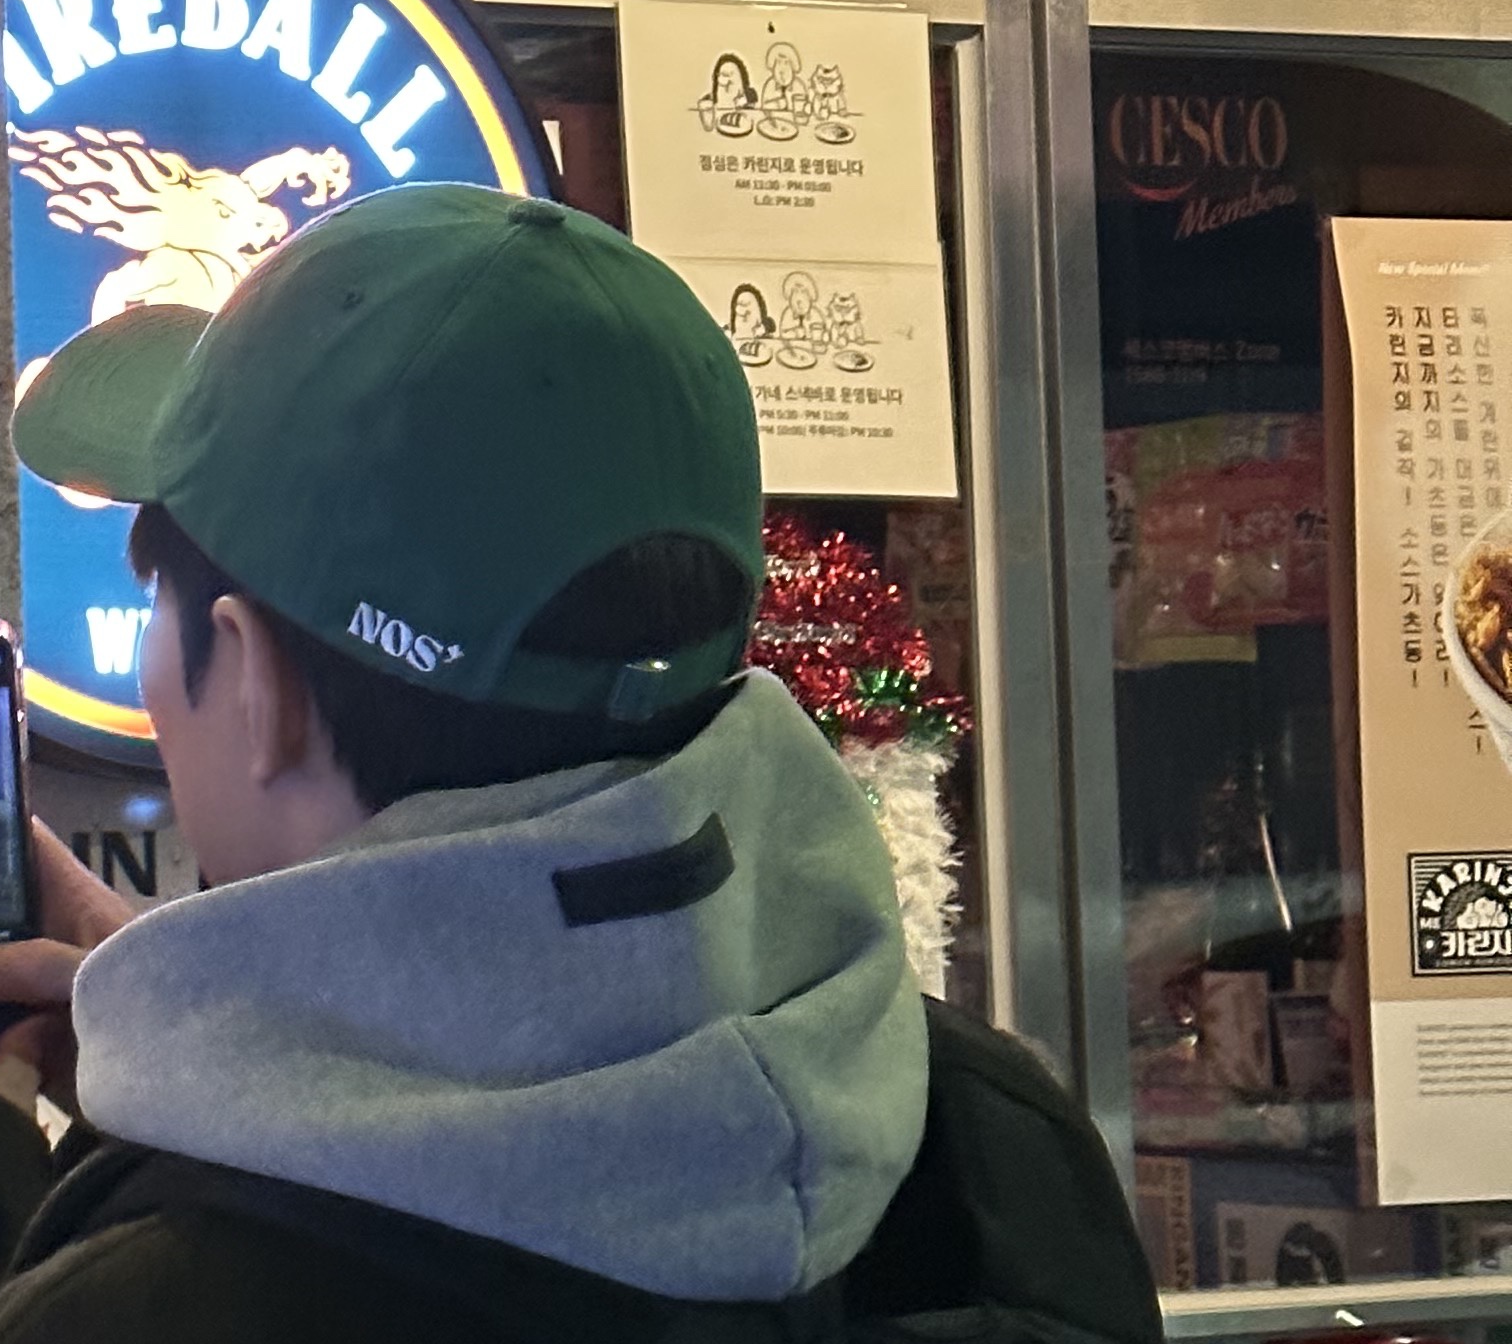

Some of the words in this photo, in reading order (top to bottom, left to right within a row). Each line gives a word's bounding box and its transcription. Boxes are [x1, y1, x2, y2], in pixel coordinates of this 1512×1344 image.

[699, 154, 738, 172] 점심은
[800, 158, 864, 176] 운영됩니다
[1108, 93, 1288, 170] CESCO
[787, 180, 803, 191] PM
[1173, 174, 1299, 241] Members
[840, 386, 903, 405] 운영됩니다
[1413, 306, 1441, 440] 지금까지의
[1386, 306, 1412, 411] 카린지의
[1400, 527, 1423, 689] 소스가츠동!
[86, 607, 152, 674] W
